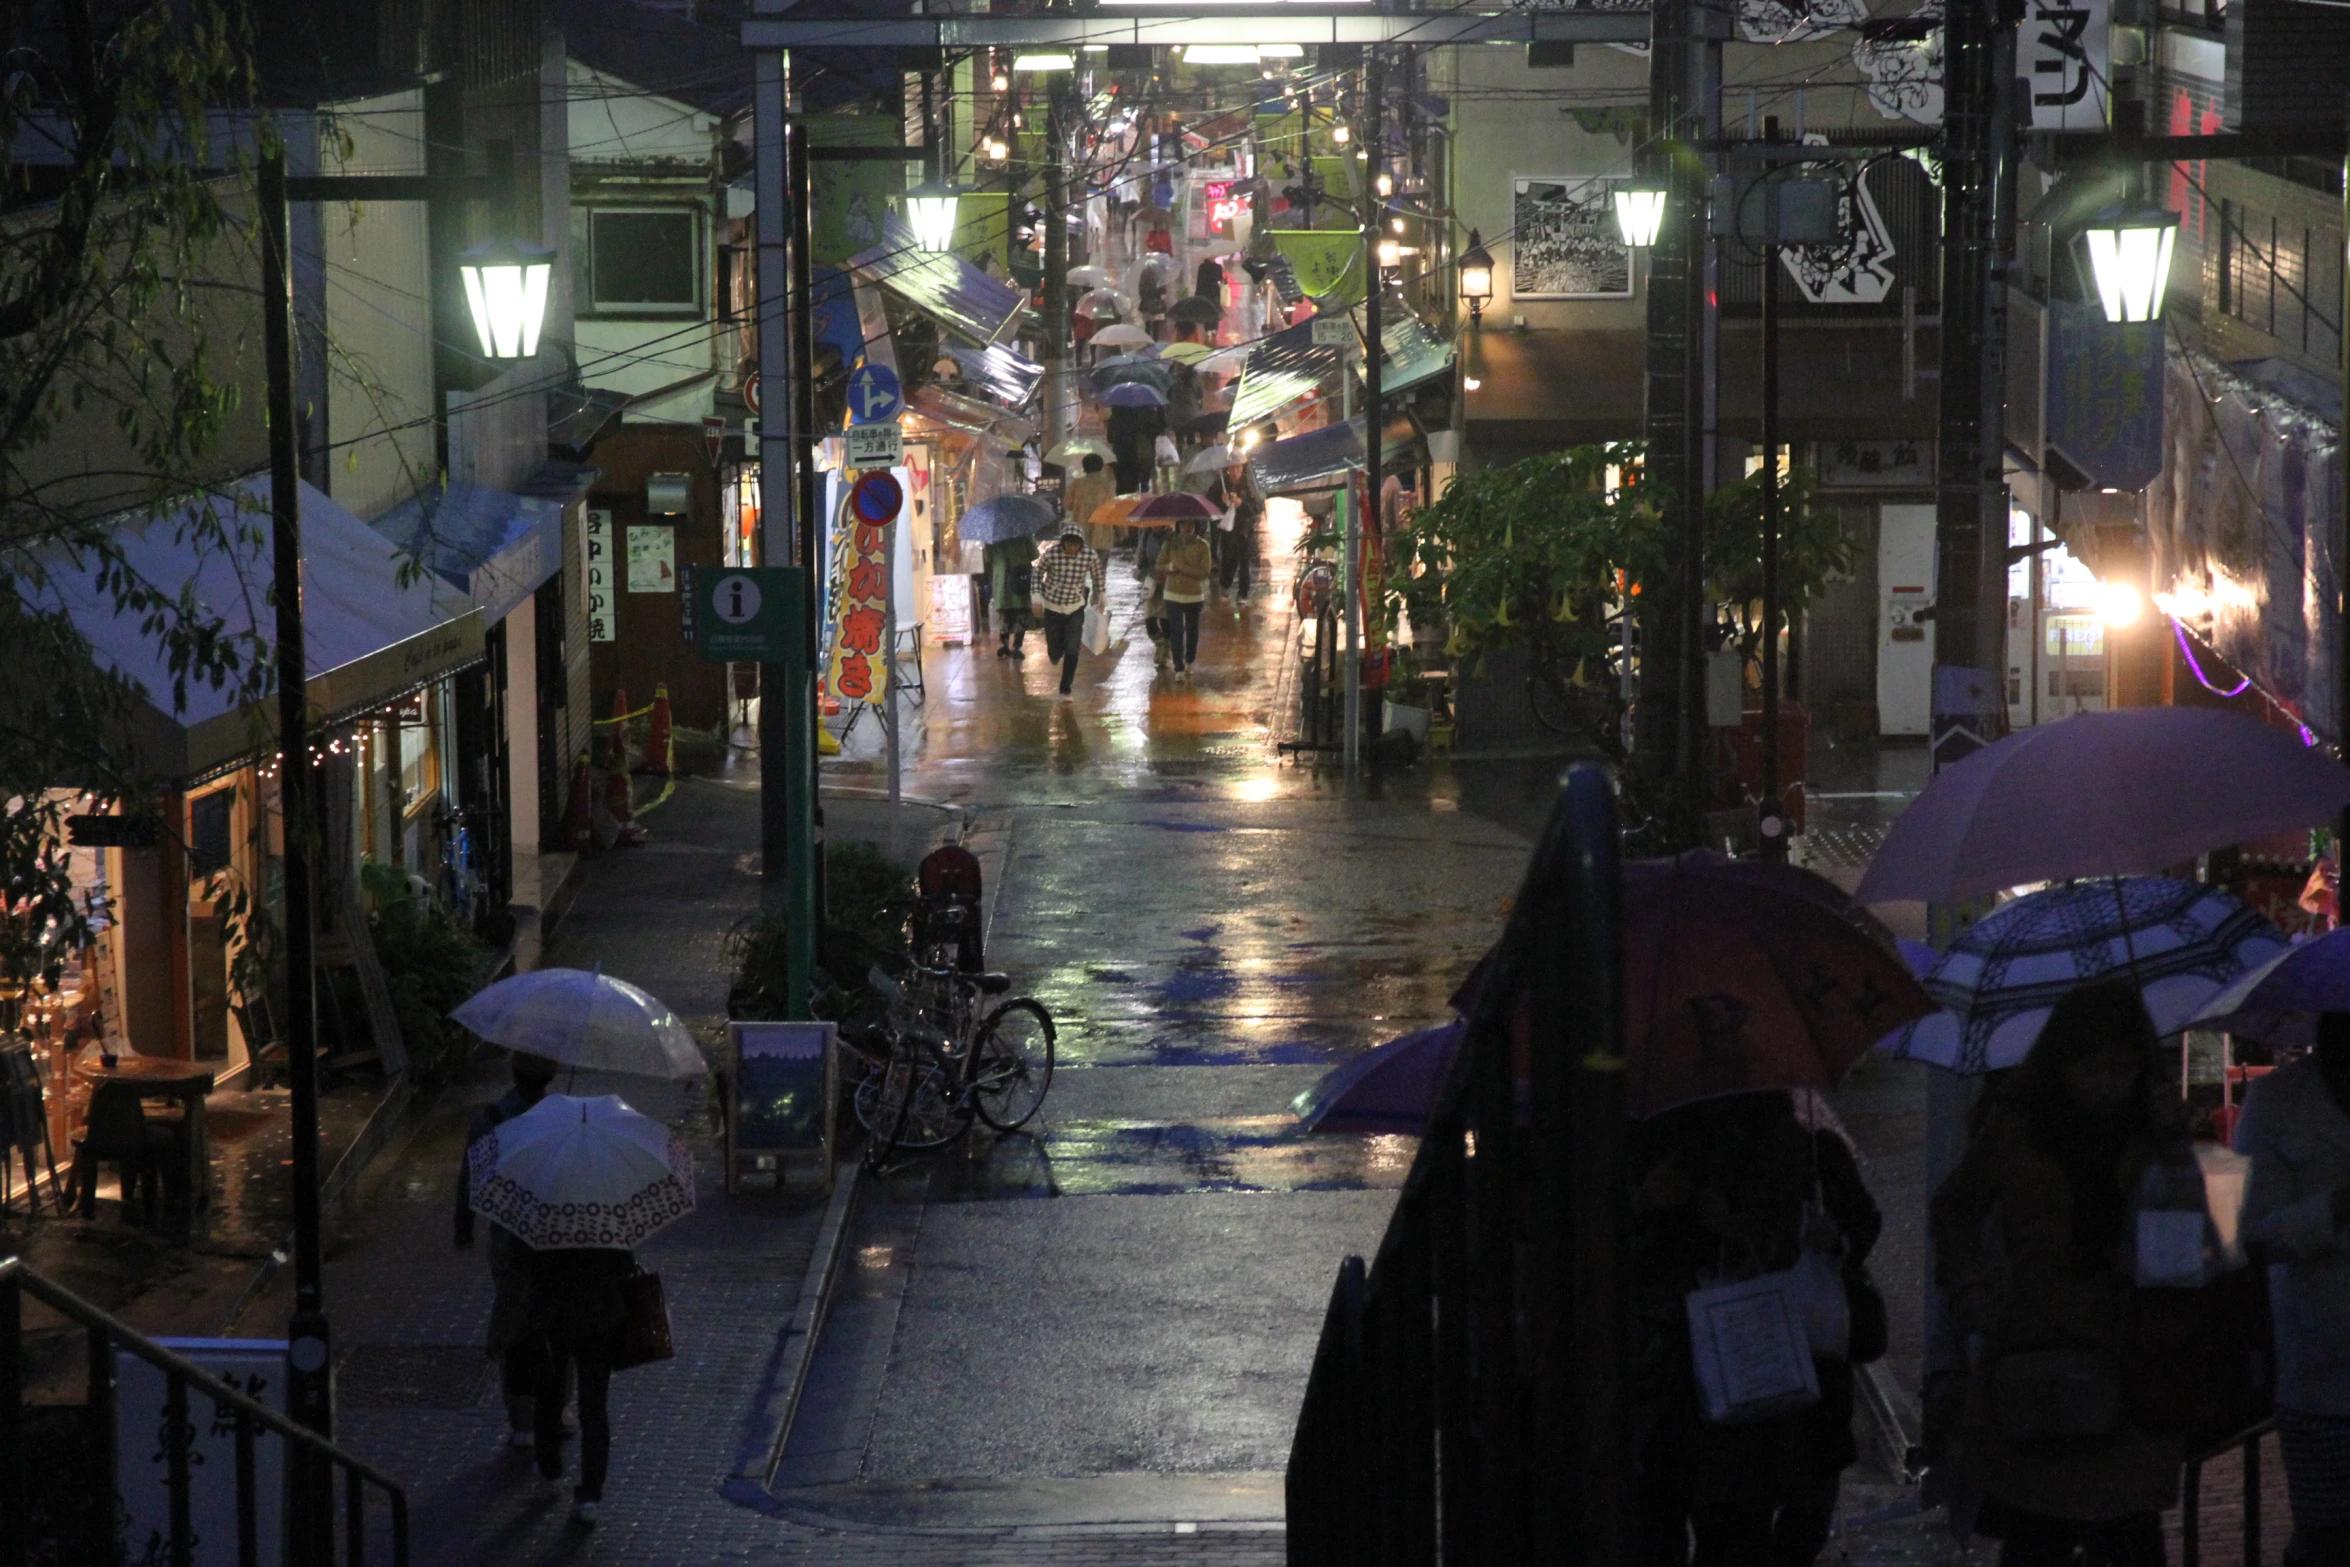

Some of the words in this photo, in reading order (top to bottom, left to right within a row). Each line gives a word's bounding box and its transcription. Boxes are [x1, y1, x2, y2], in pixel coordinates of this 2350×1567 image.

[1341, 332, 1354, 342] 20
[852, 428, 898, 441] 自転車を除く
[852, 441, 898, 453] 一方通行
